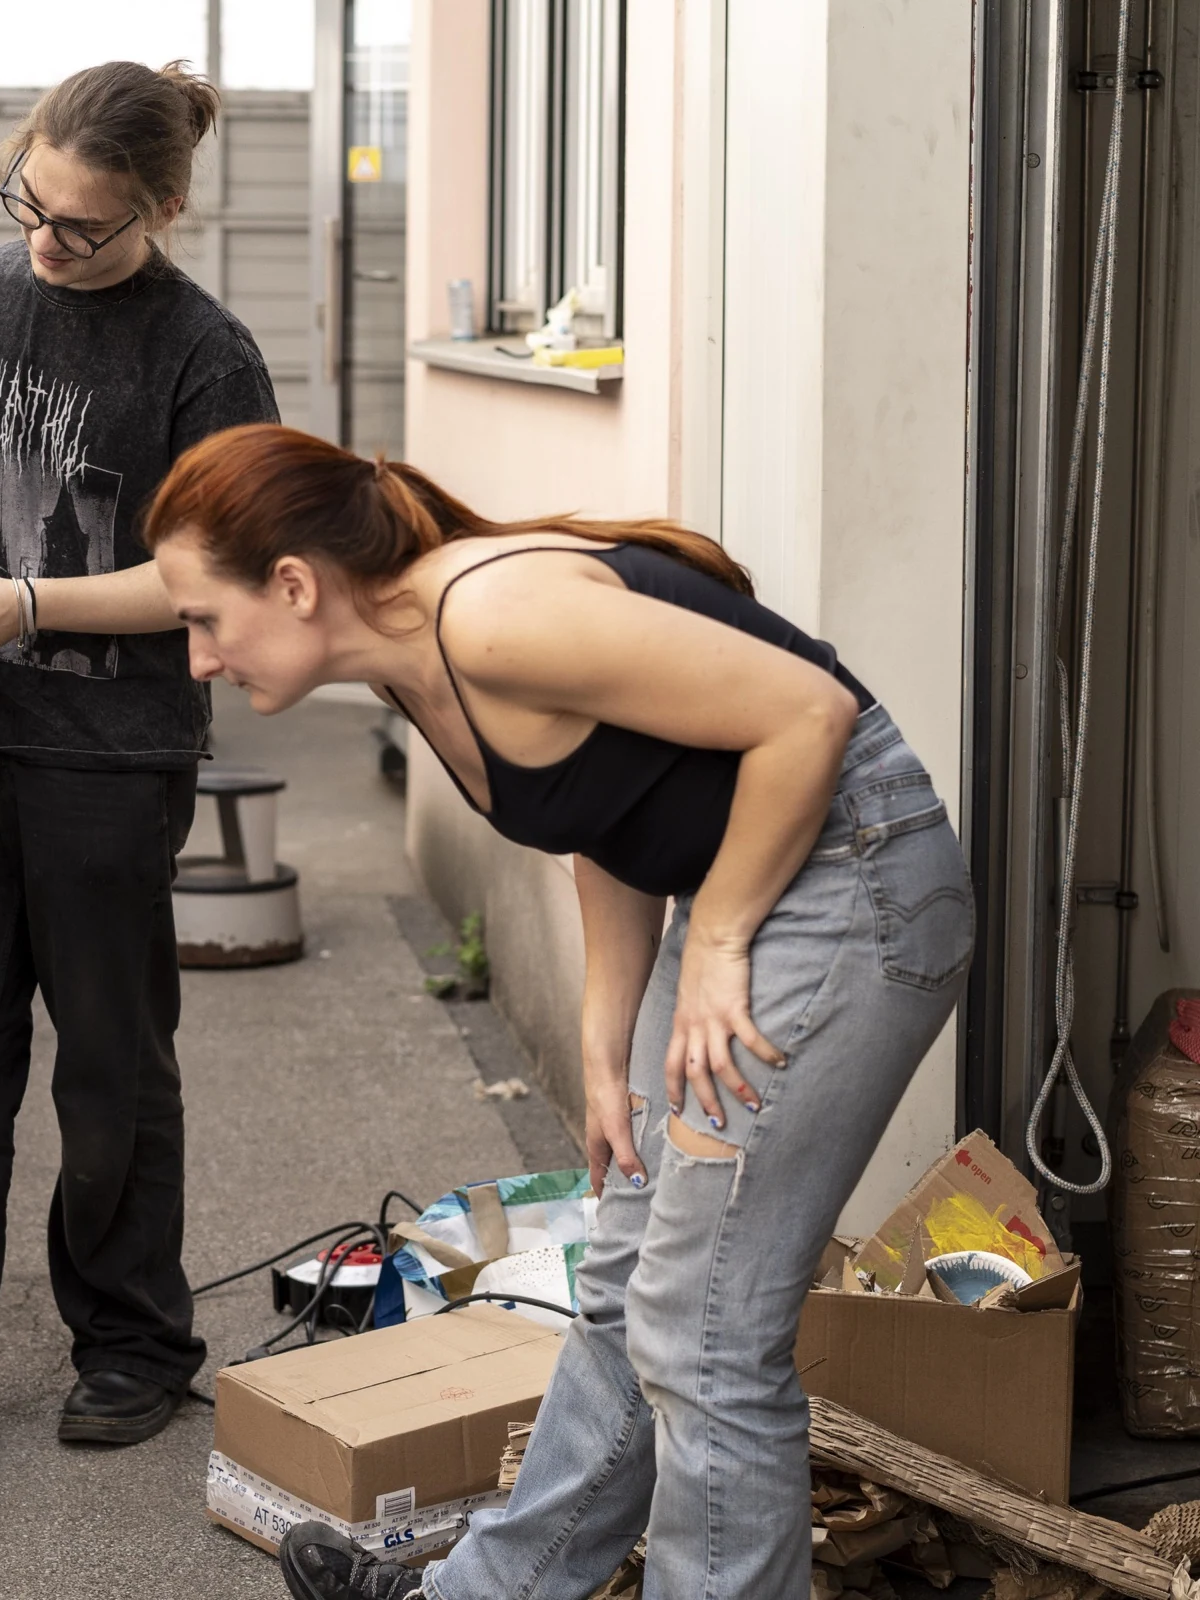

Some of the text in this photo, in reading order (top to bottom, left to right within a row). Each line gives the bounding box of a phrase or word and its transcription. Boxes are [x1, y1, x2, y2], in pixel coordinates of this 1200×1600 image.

[971, 1163, 992, 1185] open
[253, 1506, 292, 1535] AT 530
[384, 1528, 415, 1548] GLS
